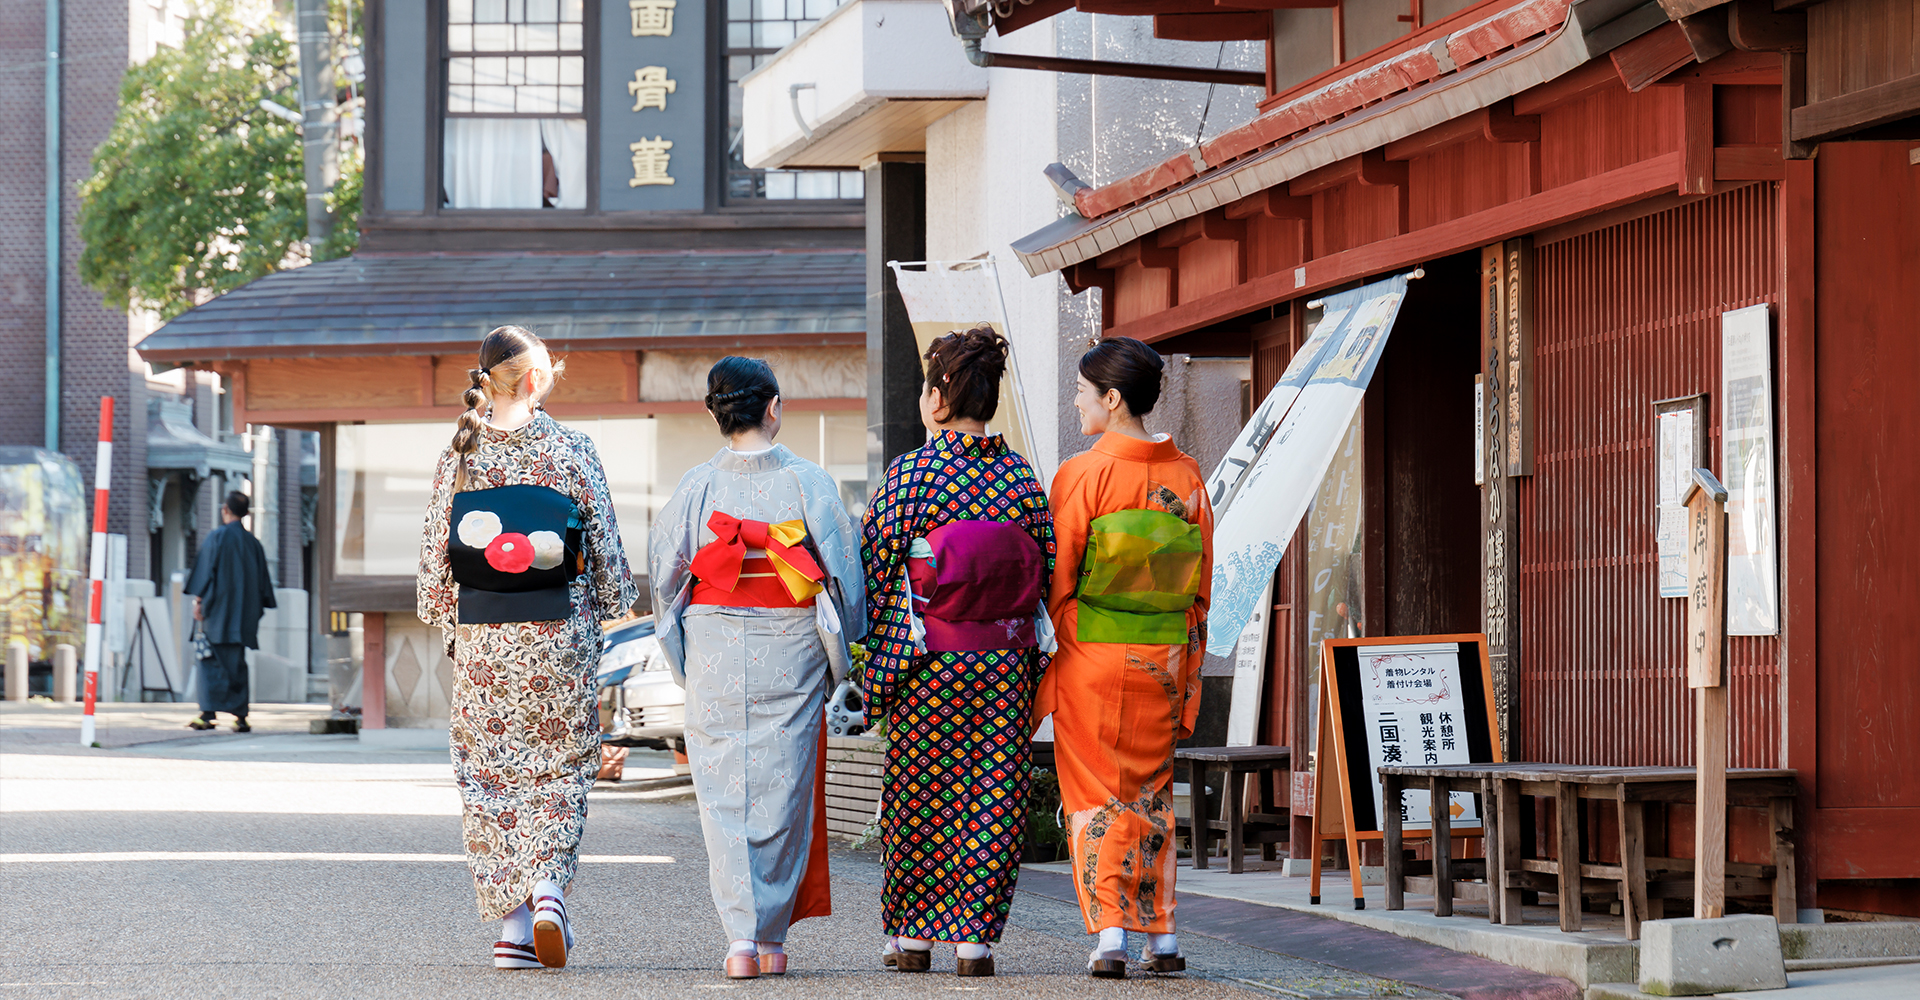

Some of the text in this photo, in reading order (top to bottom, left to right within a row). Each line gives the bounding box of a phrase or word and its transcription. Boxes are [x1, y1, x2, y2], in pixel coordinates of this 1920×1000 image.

[628, 0, 677, 188] 画骨董
[1692, 506, 1708, 672] 開館中
[1385, 667, 1436, 677] 着物レンタル
[1386, 679, 1433, 689] 着付け会場
[1419, 712, 1438, 764] 観光案内
[1439, 711, 1455, 751] 休憩所
